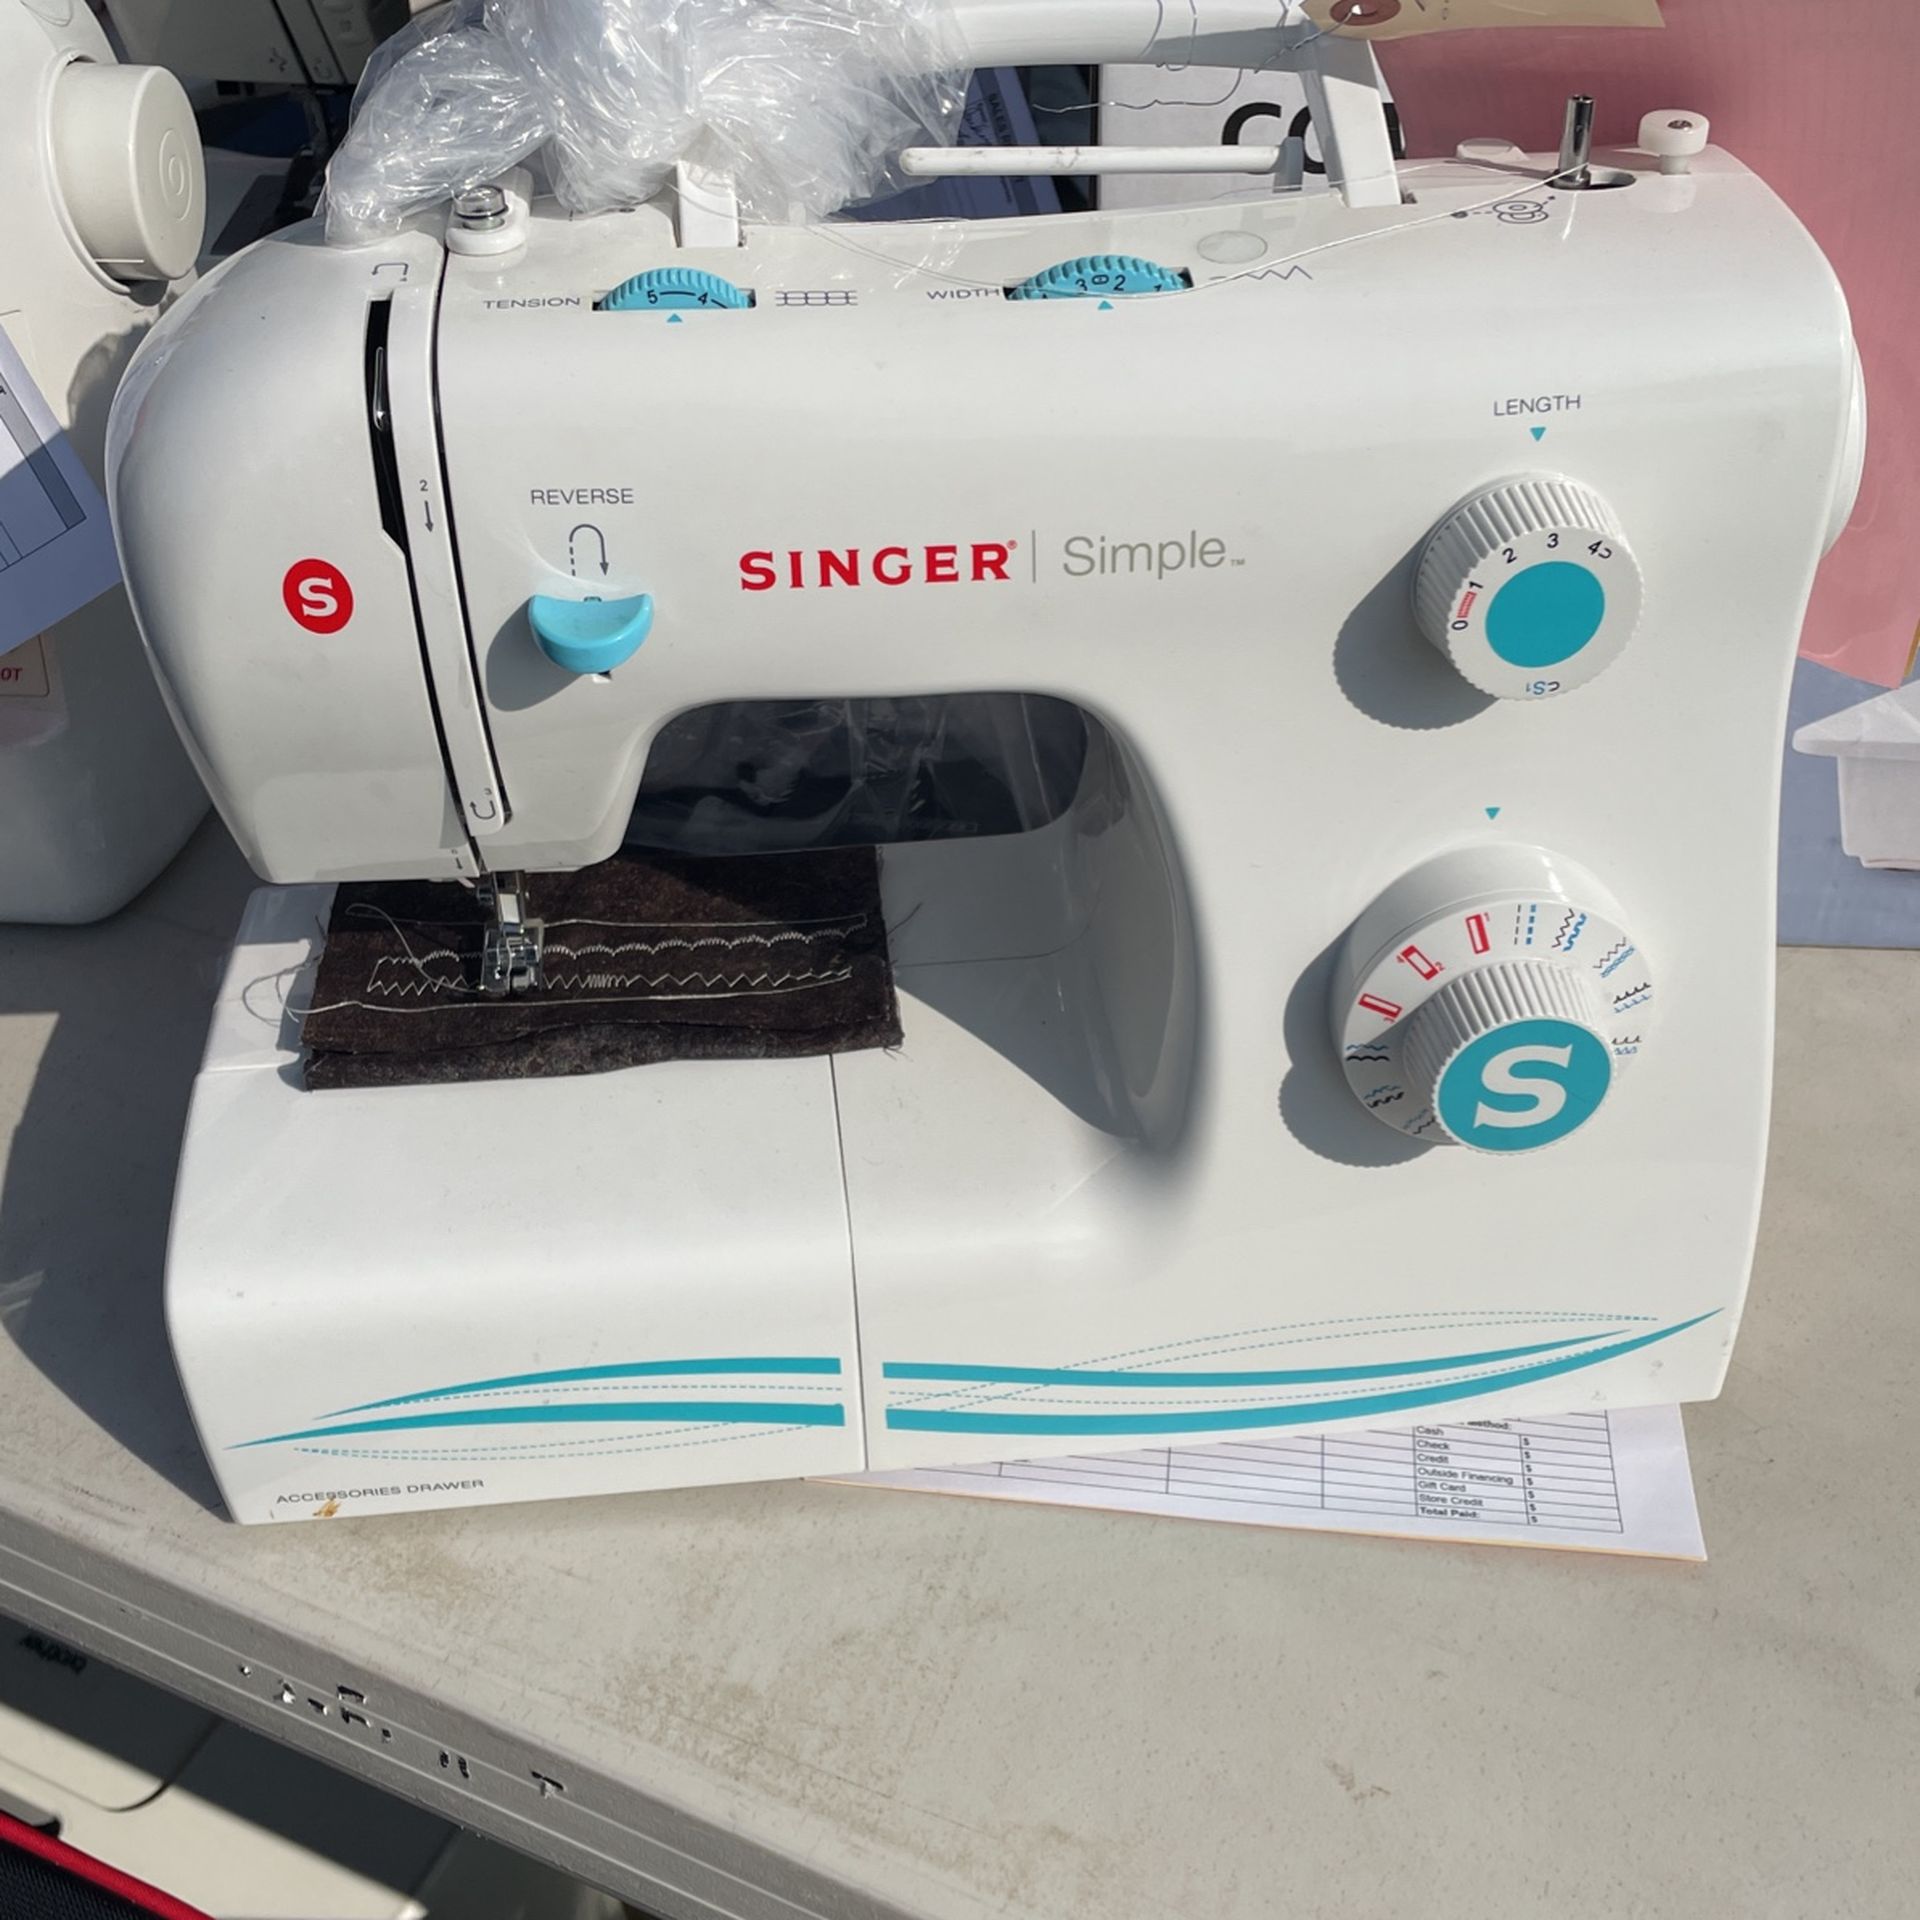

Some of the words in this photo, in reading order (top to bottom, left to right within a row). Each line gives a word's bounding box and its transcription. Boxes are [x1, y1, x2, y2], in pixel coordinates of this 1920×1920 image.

[1113, 274, 1127, 292] 2
[646, 289, 659, 305] 5
[697, 292, 709, 306] 4
[927, 288, 1000, 300] WIDTH
[483, 297, 581, 310] TENSION
[1493, 394, 1581, 416] LENGTH
[419, 479, 429, 492] 2
[530, 488, 635, 505] REVERSE
[1546, 532, 1560, 549] 3
[1501, 547, 1518, 563] 2
[1587, 540, 1604, 557] 4
[1468, 580, 1484, 592] 1
[298, 577, 338, 617] S
[1451, 619, 1469, 632] 0
[1473, 1043, 1574, 1130] S
[1416, 1425, 1445, 1436] Cash
[1416, 1439, 1450, 1450] Check
[1417, 1453, 1449, 1464] Credit
[1417, 1466, 1459, 1479] Outside
[1461, 1471, 1514, 1486] Financing
[276, 1485, 401, 1504] ACCESSORIES
[406, 1479, 485, 1494] DRAWER
[1418, 1480, 1437, 1490] Gift
[1439, 1481, 1467, 1493] Card
[1419, 1493, 1448, 1504] Store
[1450, 1496, 1484, 1507] Credit
[1420, 1506, 1448, 1516] Total
[1450, 1509, 1479, 1519] Paid:
